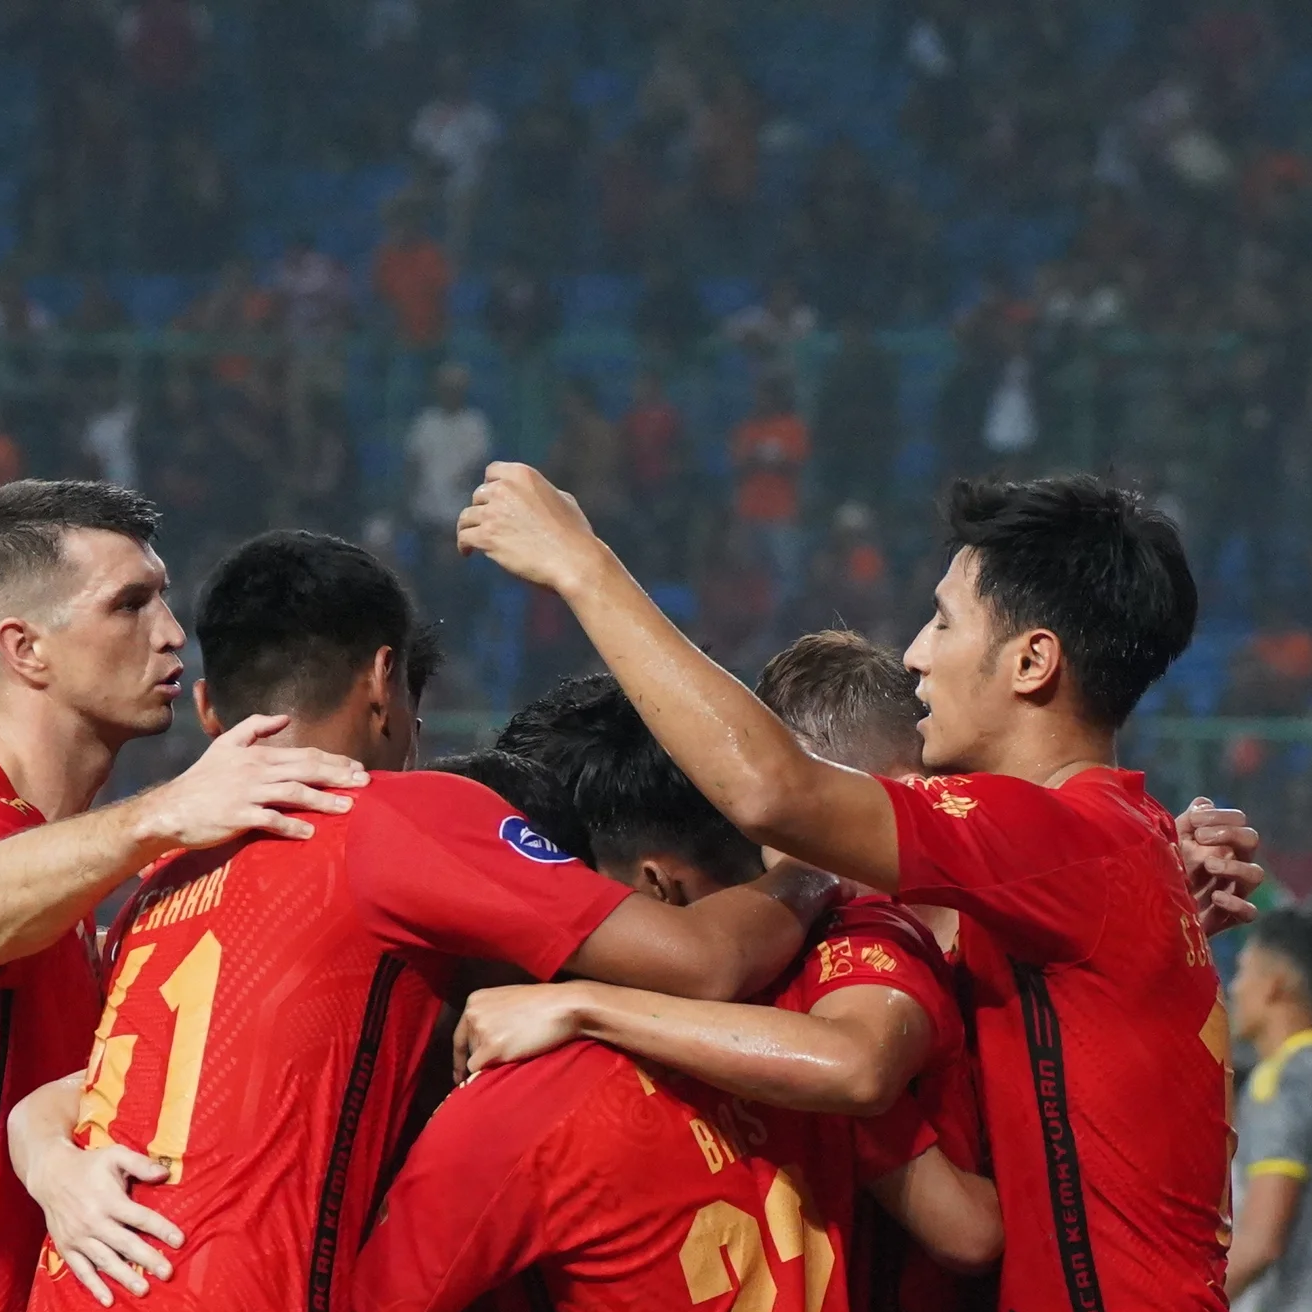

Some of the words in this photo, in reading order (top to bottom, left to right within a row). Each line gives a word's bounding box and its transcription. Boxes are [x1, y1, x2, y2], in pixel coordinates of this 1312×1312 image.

[74, 929, 222, 1184] 41
[324, 1052, 372, 1230] KEMAYORAN
[1038, 1060, 1082, 1242] KEMAYORAN
